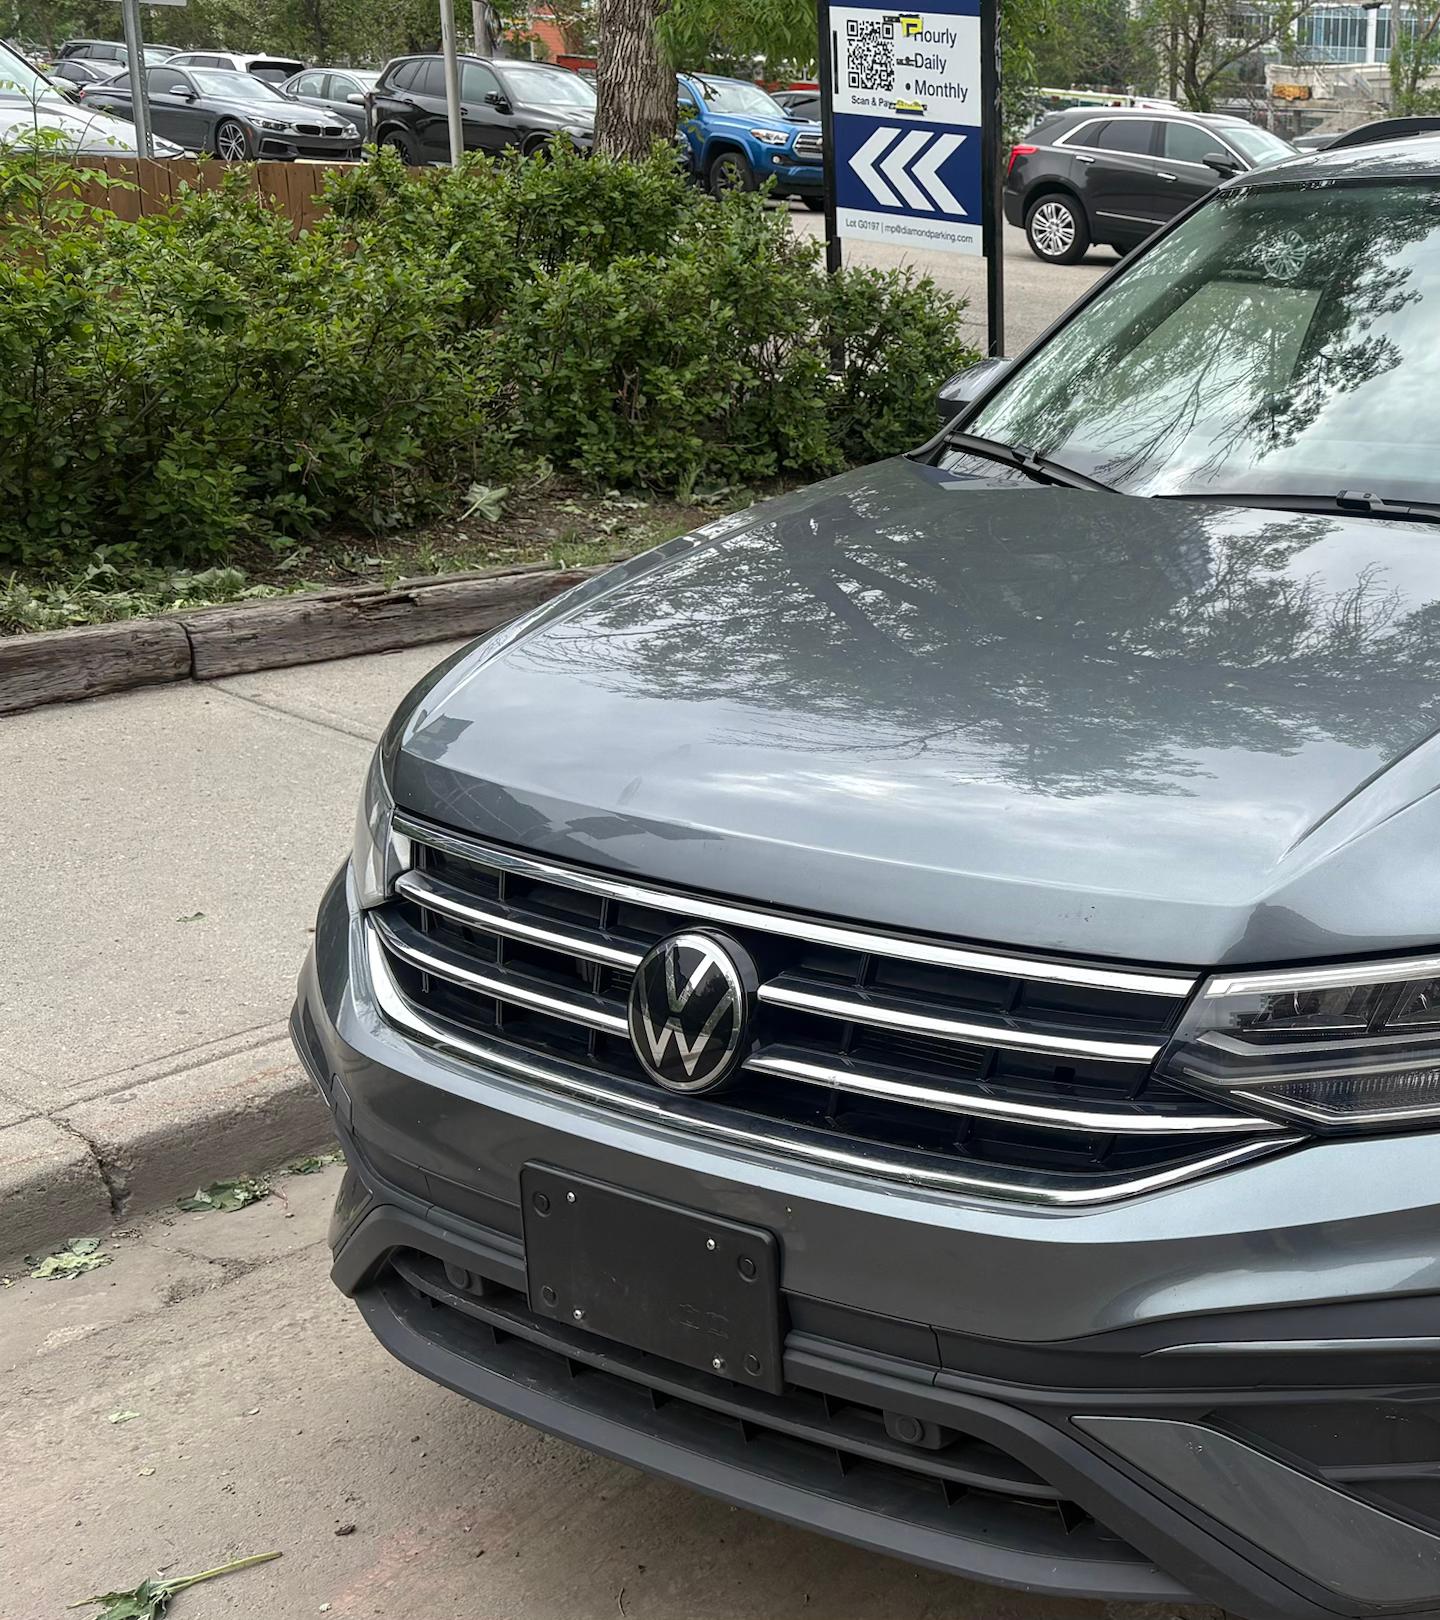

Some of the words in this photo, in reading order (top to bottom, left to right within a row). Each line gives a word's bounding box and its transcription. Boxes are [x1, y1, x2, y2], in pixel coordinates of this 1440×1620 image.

[914, 28, 957, 48] Hourly
[914, 53, 947, 74] Daily
[851, 95, 870, 106] Scan
[871, 97, 878, 107] &
[915, 79, 968, 103] Monthly
[845, 219, 856, 228] Lot
[857, 219, 879, 231] G0197
[885, 224, 973, 243] mp@diamondparking.com
